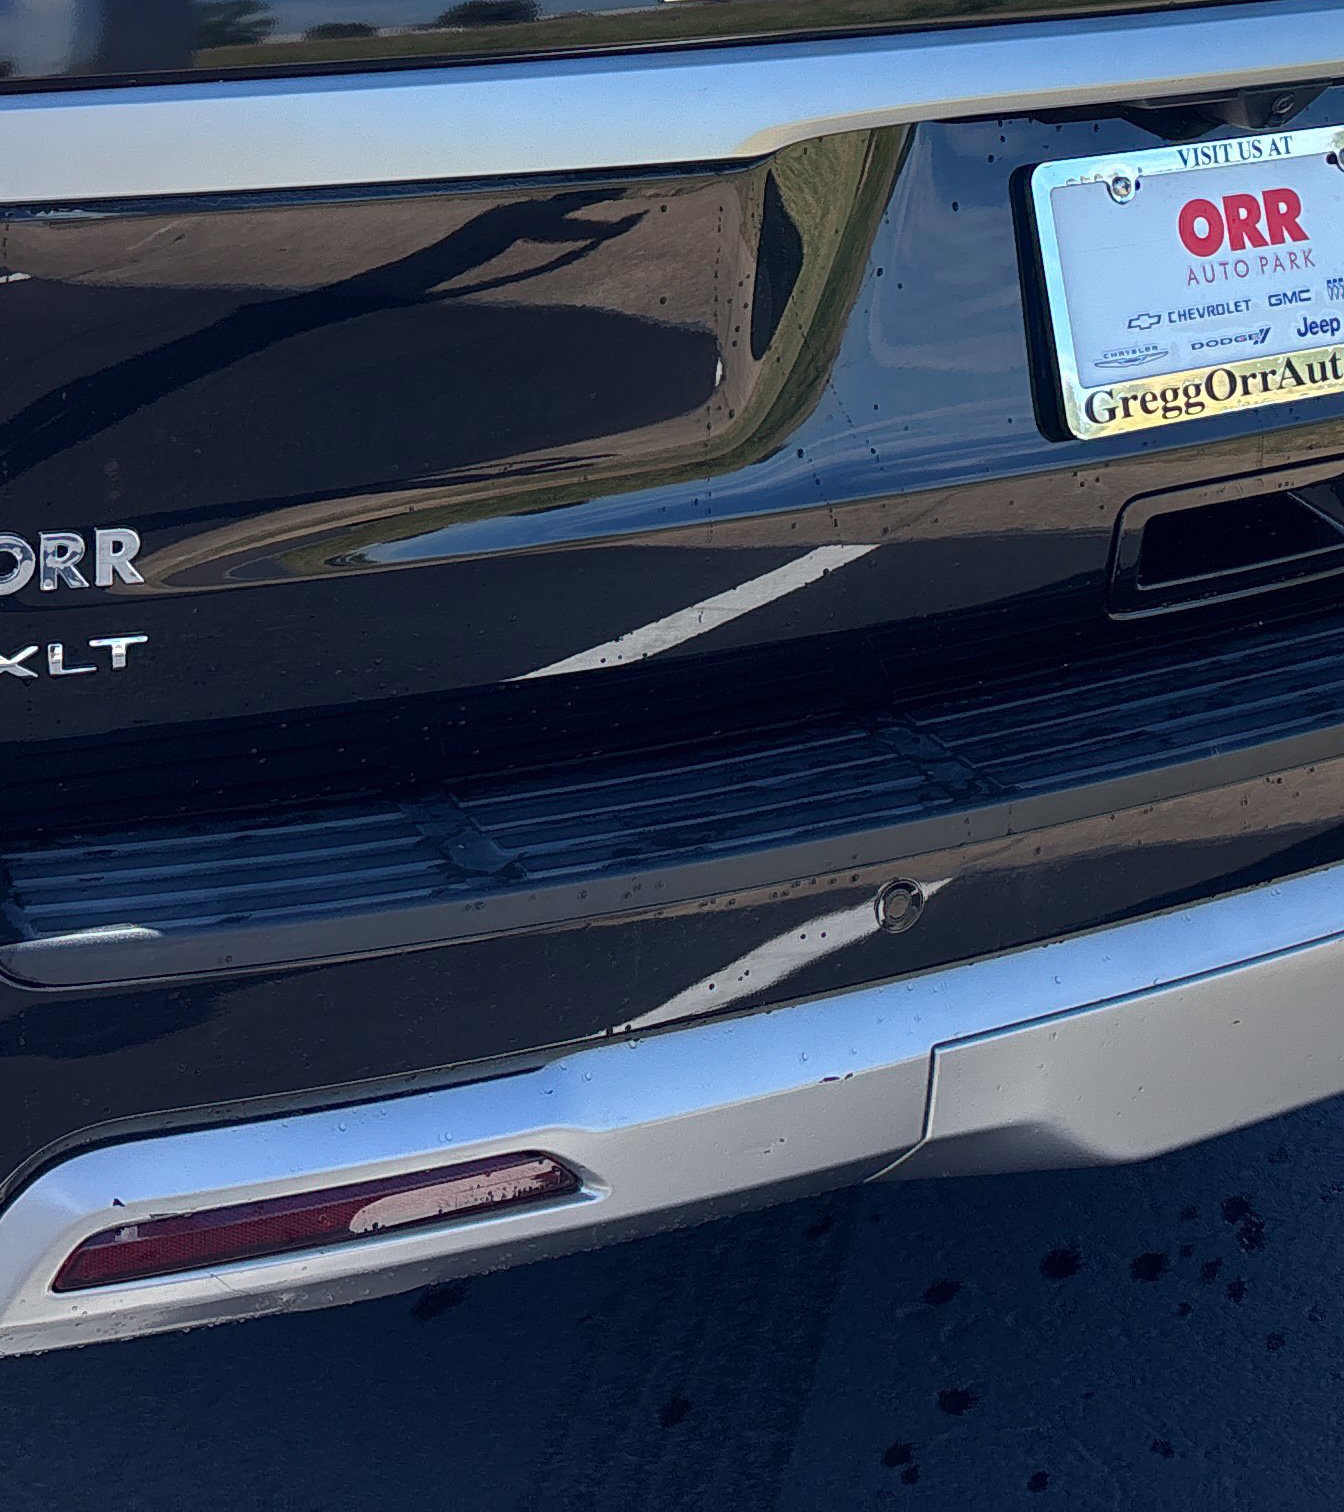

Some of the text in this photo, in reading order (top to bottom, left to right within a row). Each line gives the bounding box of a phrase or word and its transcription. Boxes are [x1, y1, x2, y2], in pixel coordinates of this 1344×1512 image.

[1176, 135, 1293, 168] VISIT US AT
[1178, 187, 1310, 257] ORR
[1187, 249, 1316, 287] AUTO PARK
[1167, 298, 1252, 324] CHEVROLET
[1268, 289, 1312, 307] GMC
[1190, 332, 1260, 351] DODGE
[1297, 317, 1341, 337] Jeep
